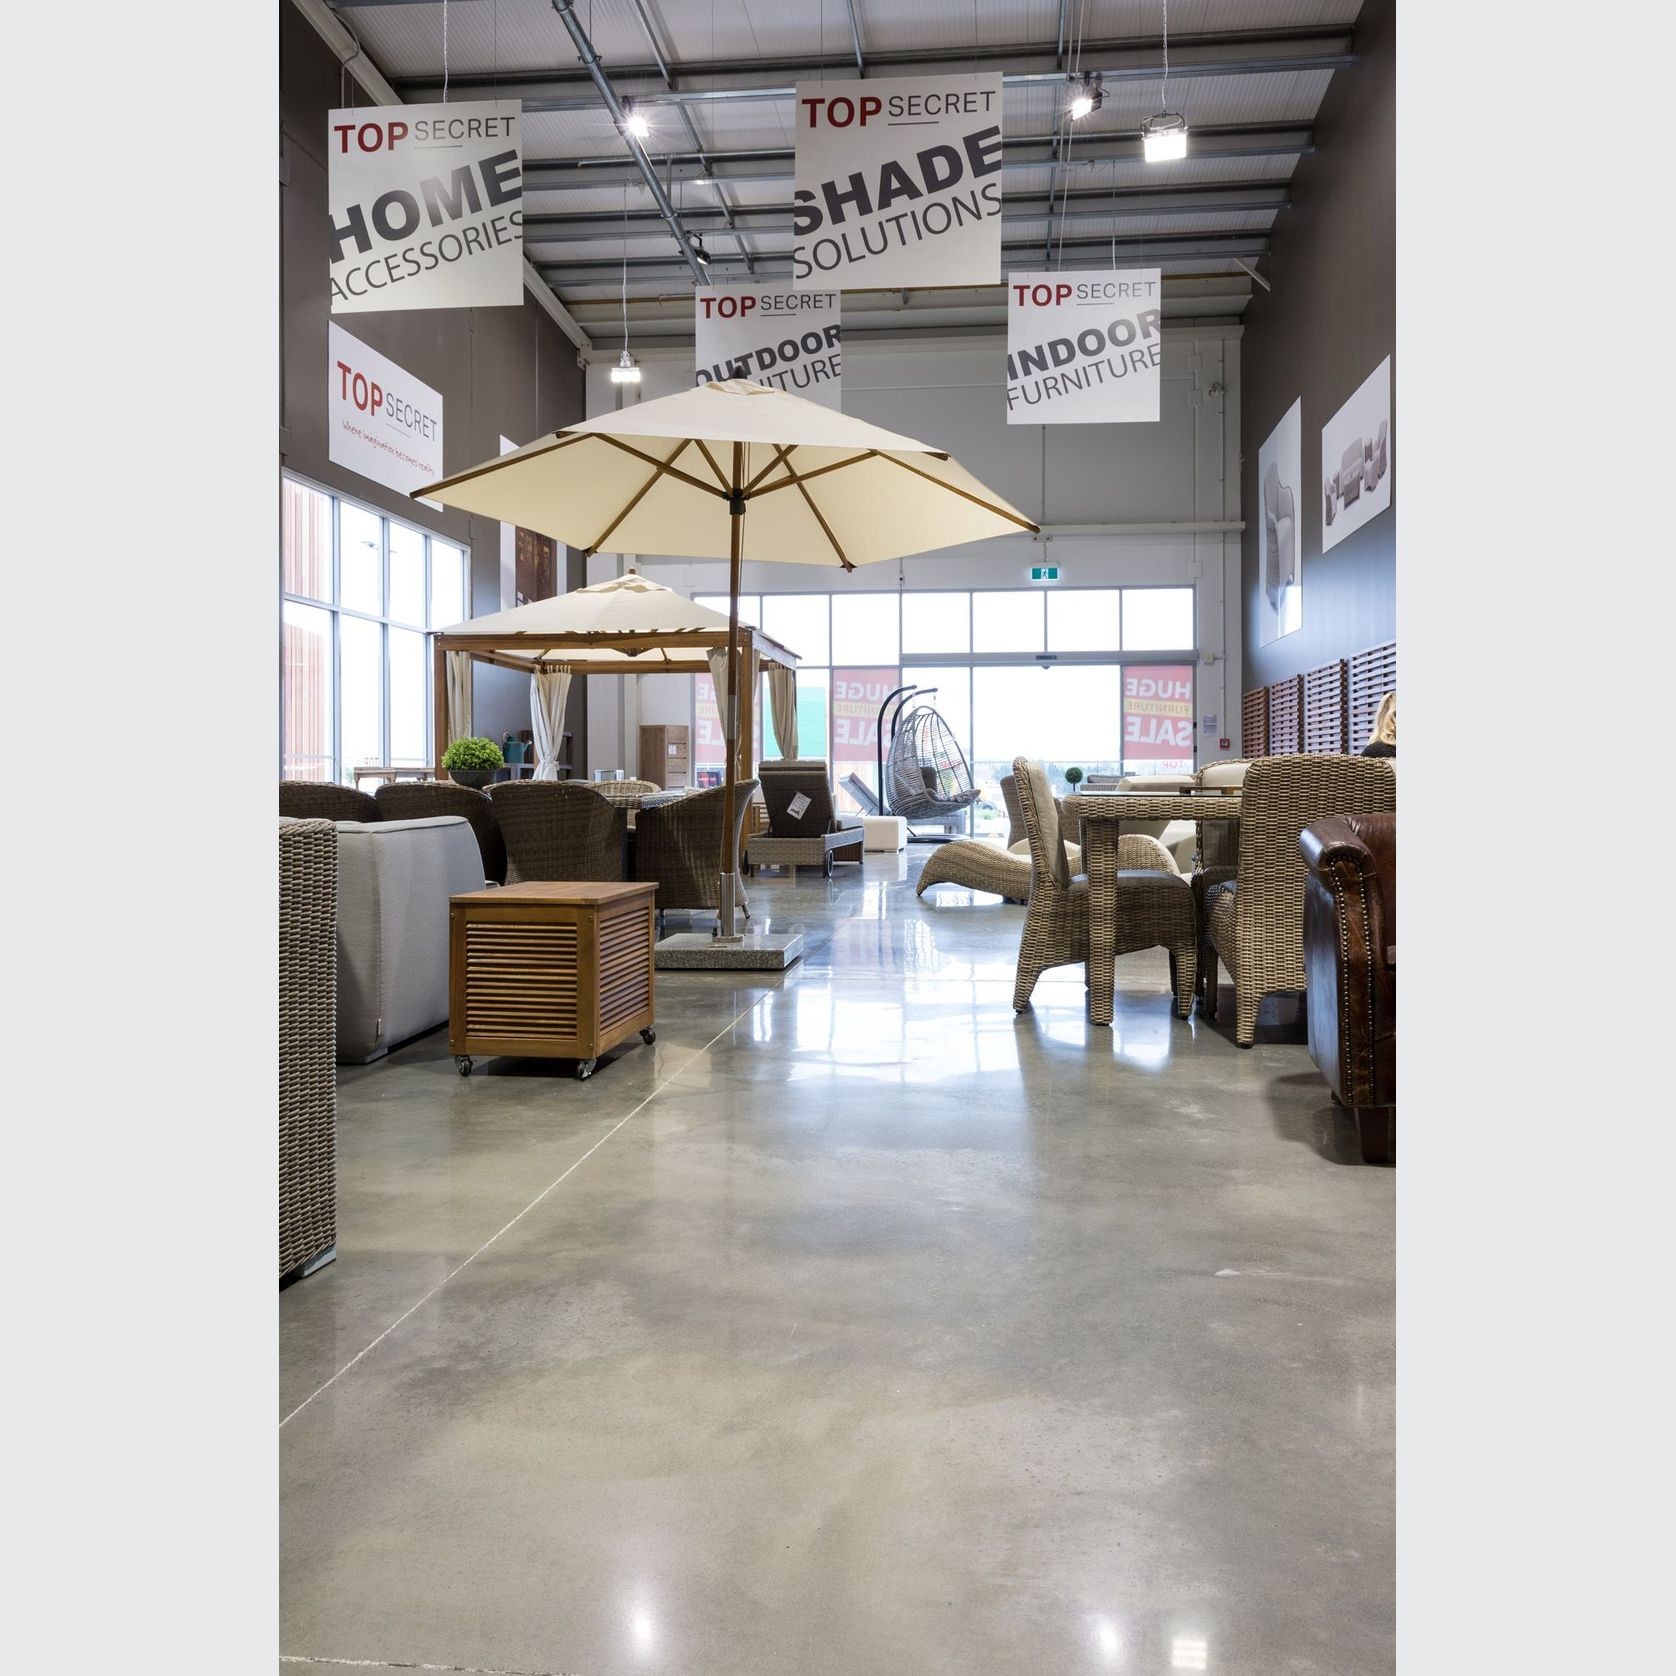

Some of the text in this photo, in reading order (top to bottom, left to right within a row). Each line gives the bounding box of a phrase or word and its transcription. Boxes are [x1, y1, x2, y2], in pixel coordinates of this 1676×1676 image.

[334, 117, 515, 153] TOP SECRET
[802, 91, 996, 128] TOP SECRET
[329, 149, 522, 264] HOME
[793, 125, 1002, 236] SHADE
[330, 210, 522, 301] ACCESSORIES
[793, 183, 1002, 279] SOLUTIONS
[700, 294, 836, 319] TOP SECRET
[1013, 281, 1156, 307] TOP SECRET
[696, 324, 841, 387] OUTDOOR
[759, 353, 841, 392] ITURE
[1007, 343, 1160, 411] FURNITURE
[1008, 309, 1160, 381] INDOOR
[337, 360, 437, 442] TOP SECRET
